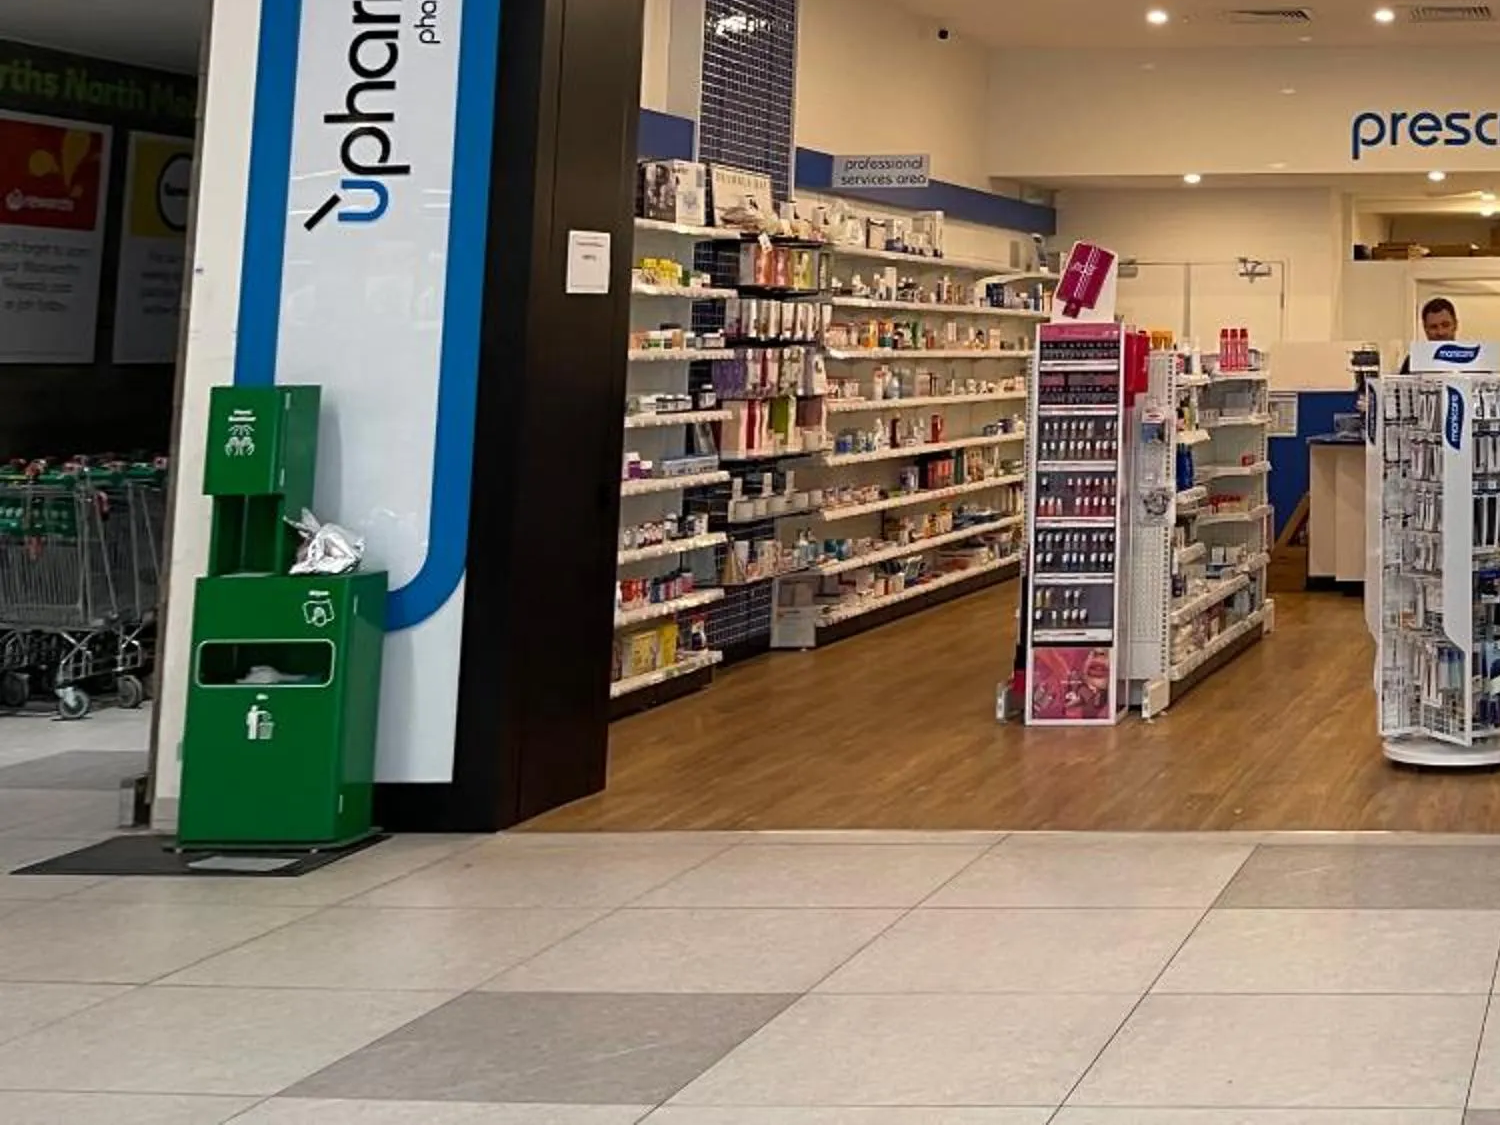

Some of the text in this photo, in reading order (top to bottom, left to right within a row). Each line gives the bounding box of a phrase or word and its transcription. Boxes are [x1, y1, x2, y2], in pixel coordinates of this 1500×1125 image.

[845, 156, 923, 171] professional
[841, 175, 927, 185] services area
[1451, 394, 1459, 442] manicare
